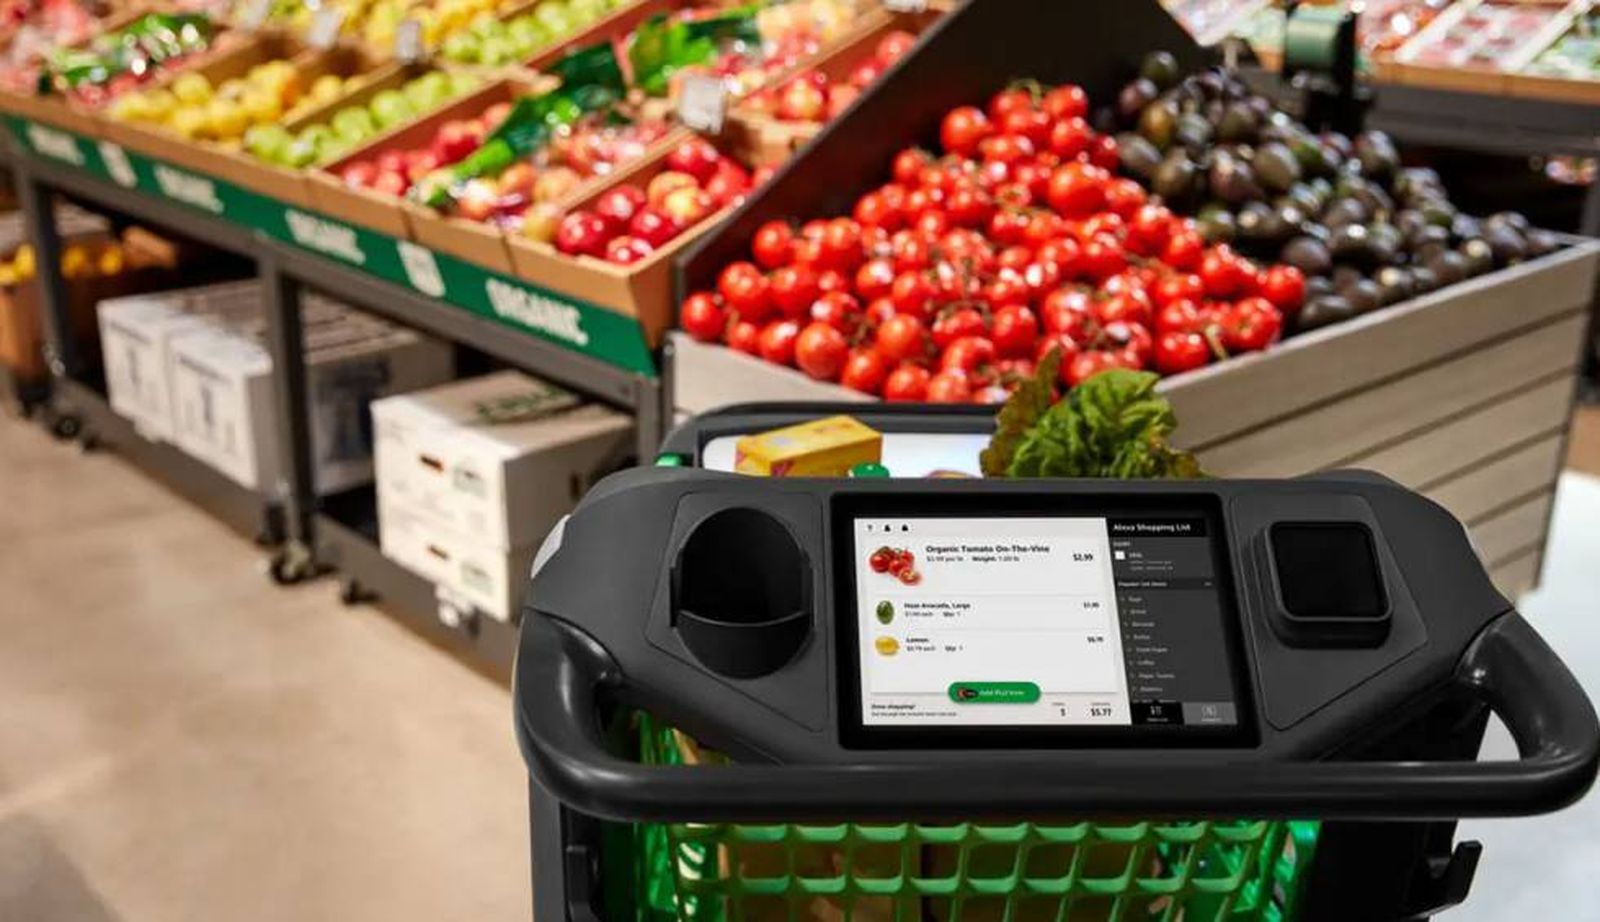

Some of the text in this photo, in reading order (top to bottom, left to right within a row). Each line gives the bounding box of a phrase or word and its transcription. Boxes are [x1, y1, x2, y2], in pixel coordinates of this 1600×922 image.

[1113, 523, 1191, 532] Alexa Shopping List
[926, 544, 1050, 554] Organic Tomato On-The-Vine
[1072, 553, 1093, 561] $2.99
